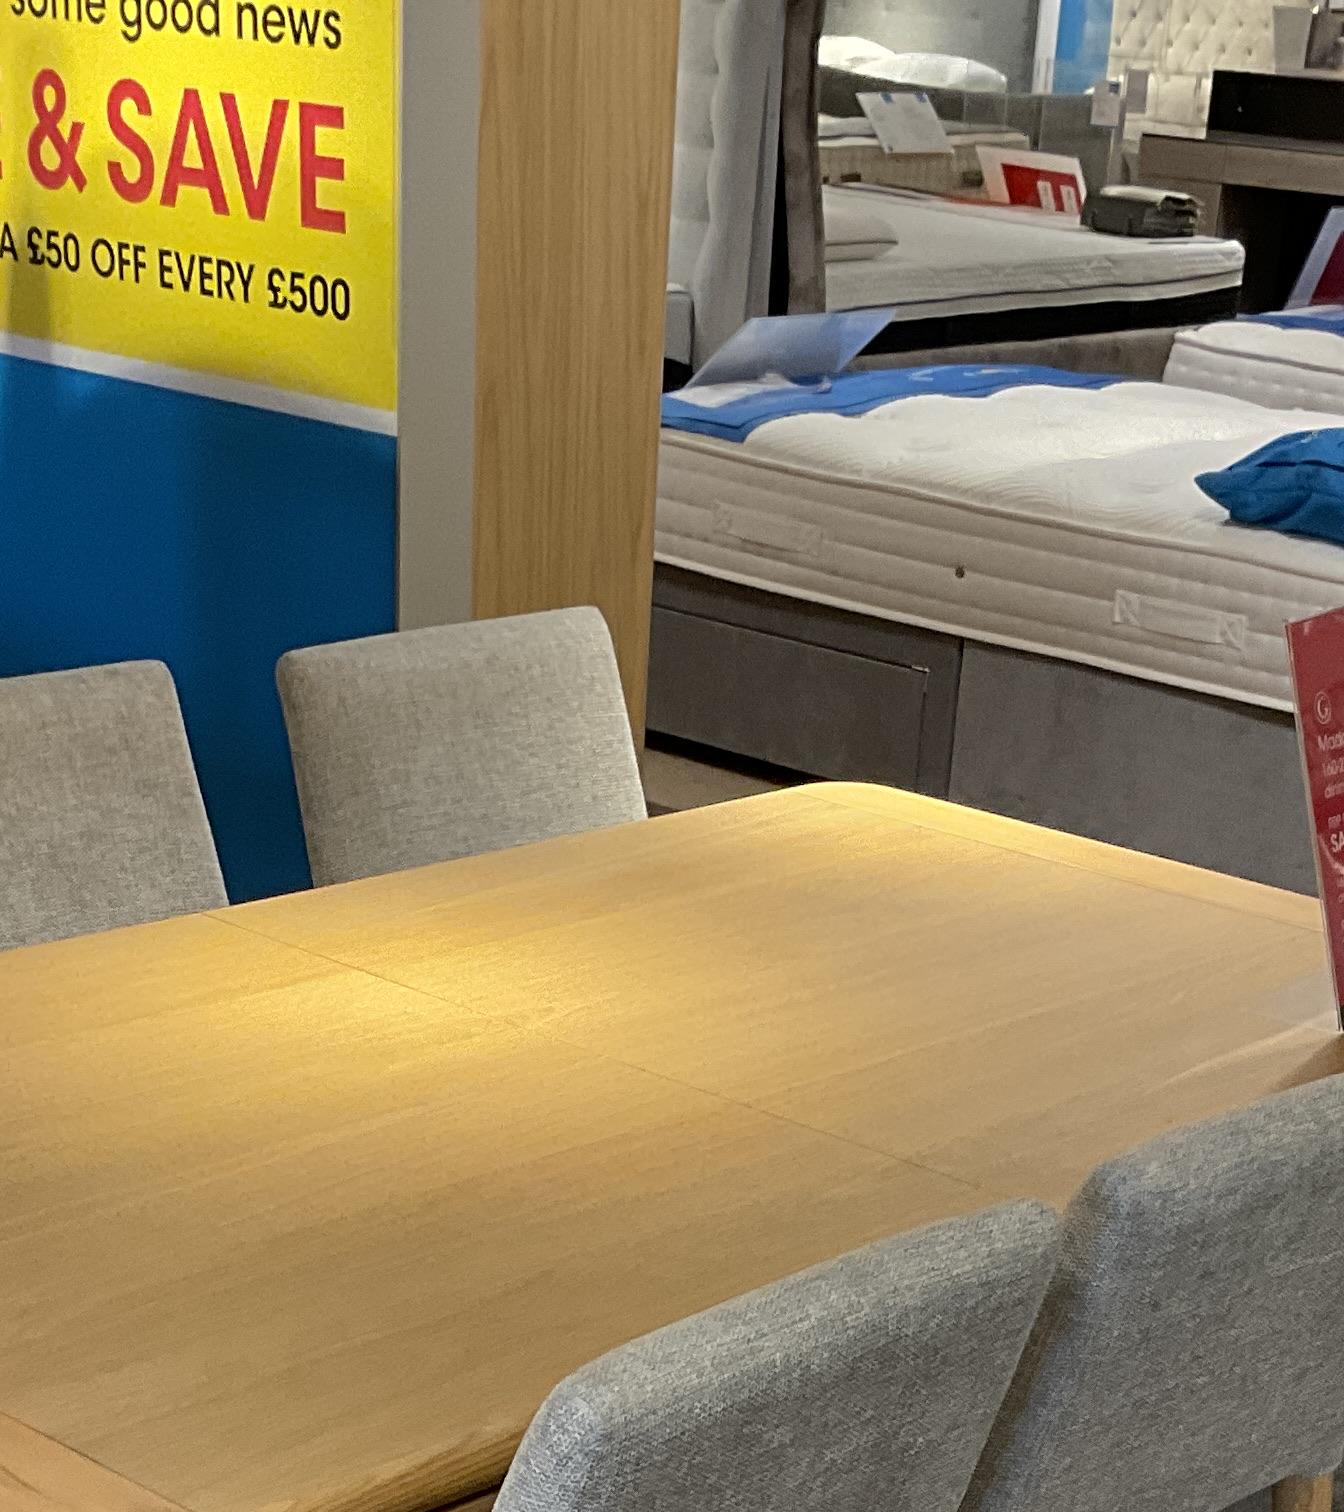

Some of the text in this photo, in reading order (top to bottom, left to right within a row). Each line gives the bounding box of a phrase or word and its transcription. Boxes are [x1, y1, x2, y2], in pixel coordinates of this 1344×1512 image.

[120, 0, 220, 43] good
[236, 1, 342, 49] news
[27, 68, 87, 194] &
[107, 78, 347, 234] SAVE
[27, 226, 80, 273] £50
[91, 238, 147, 284] OFF
[158, 248, 255, 304] EVERY
[267, 267, 351, 321] £500
